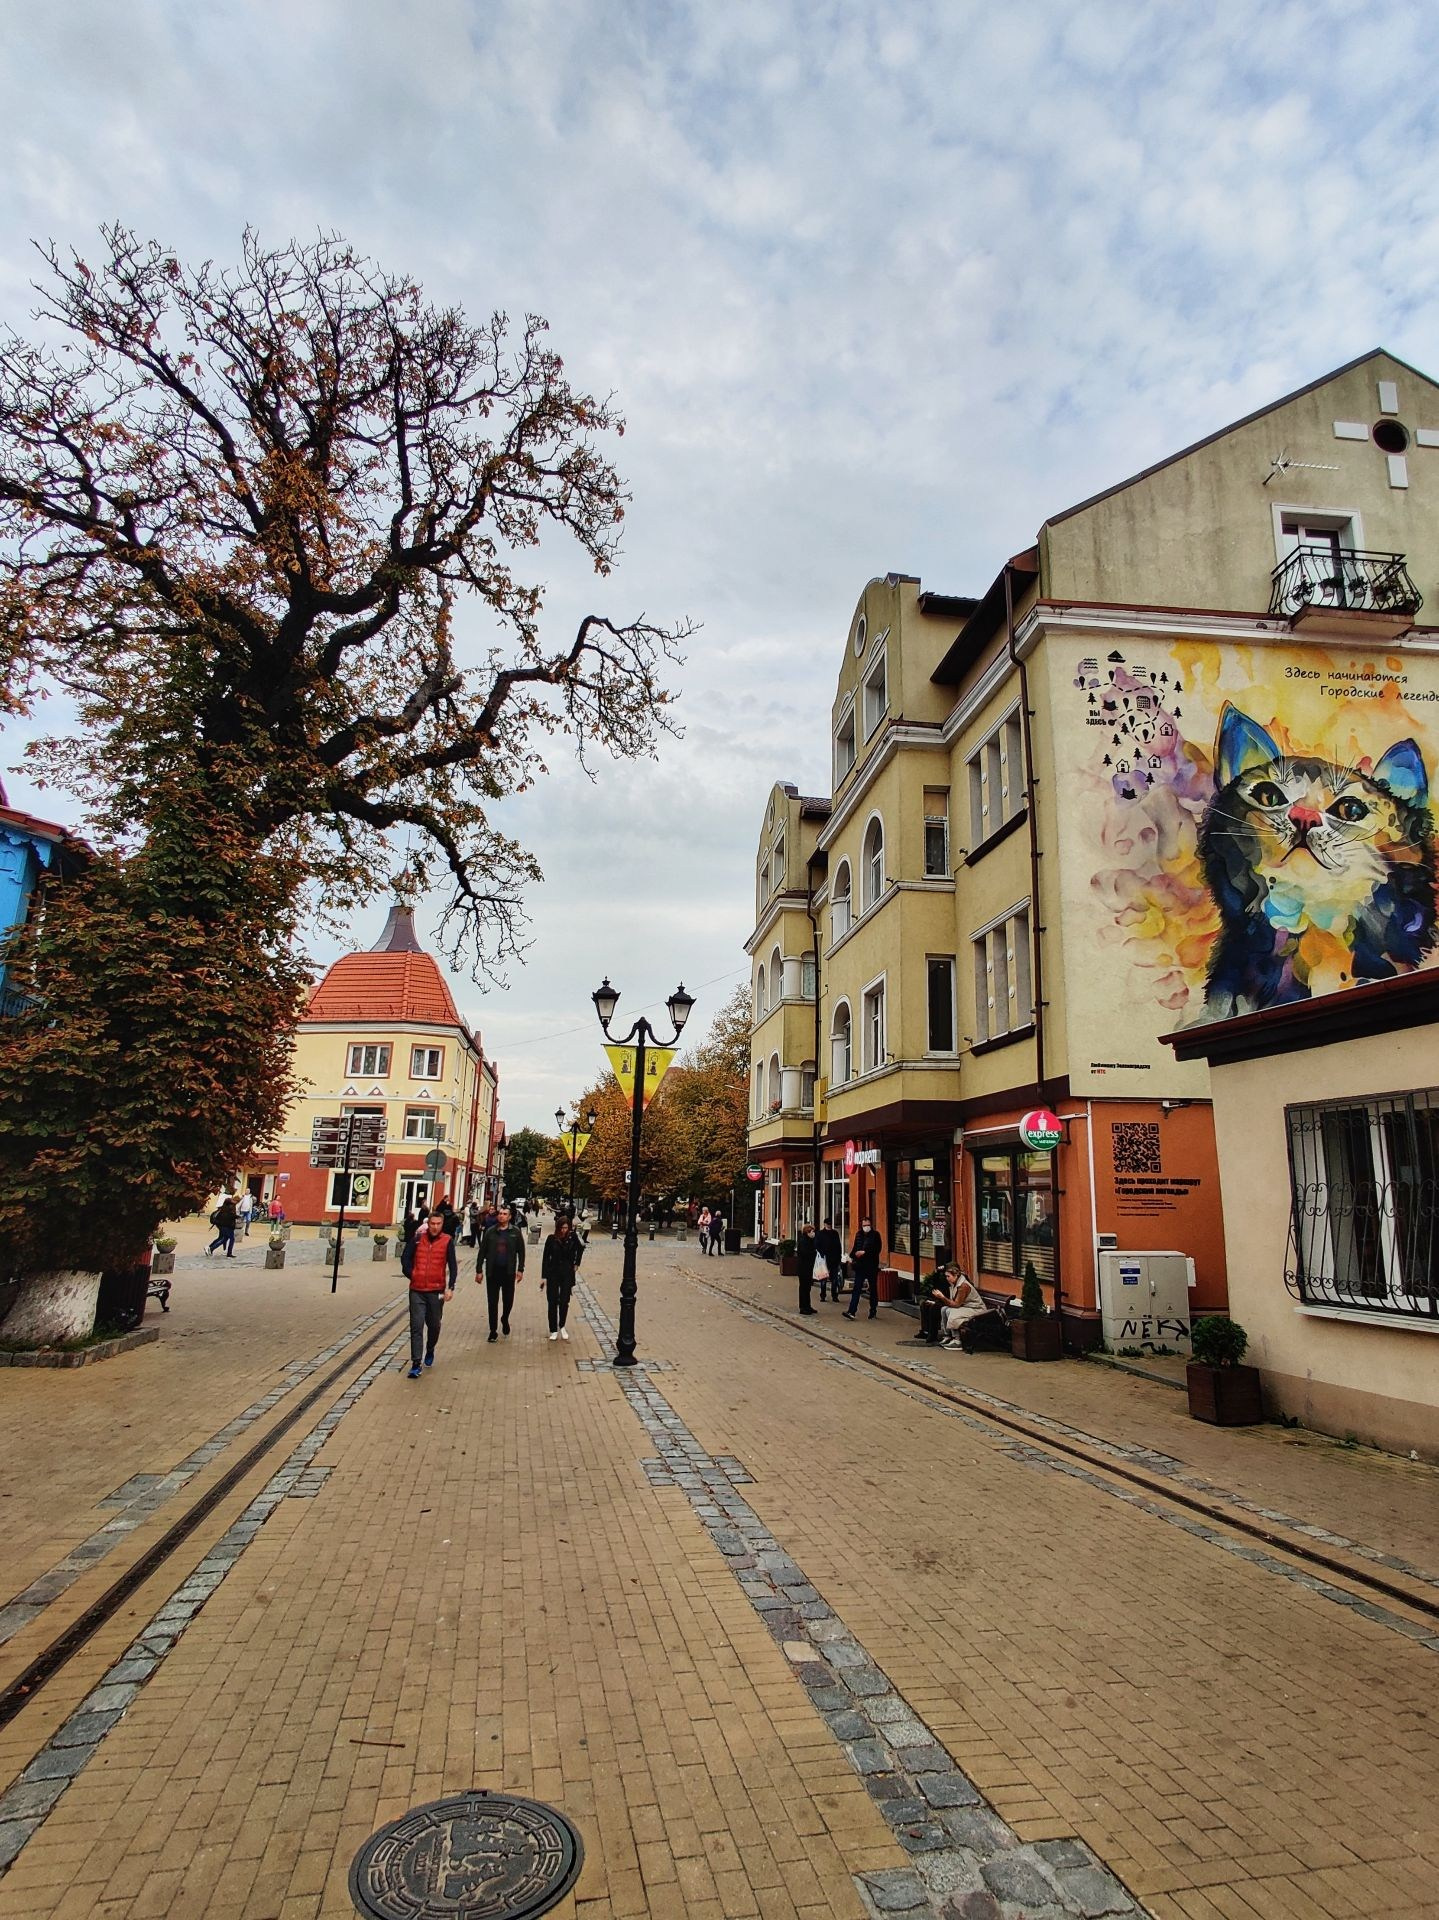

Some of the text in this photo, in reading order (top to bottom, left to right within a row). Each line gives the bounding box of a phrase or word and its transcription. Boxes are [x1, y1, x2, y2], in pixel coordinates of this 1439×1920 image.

[1284, 667, 1408, 684] Здесь начинаются
[1320, 686, 1385, 699] Городские
[1027, 1130, 1059, 1140] express
